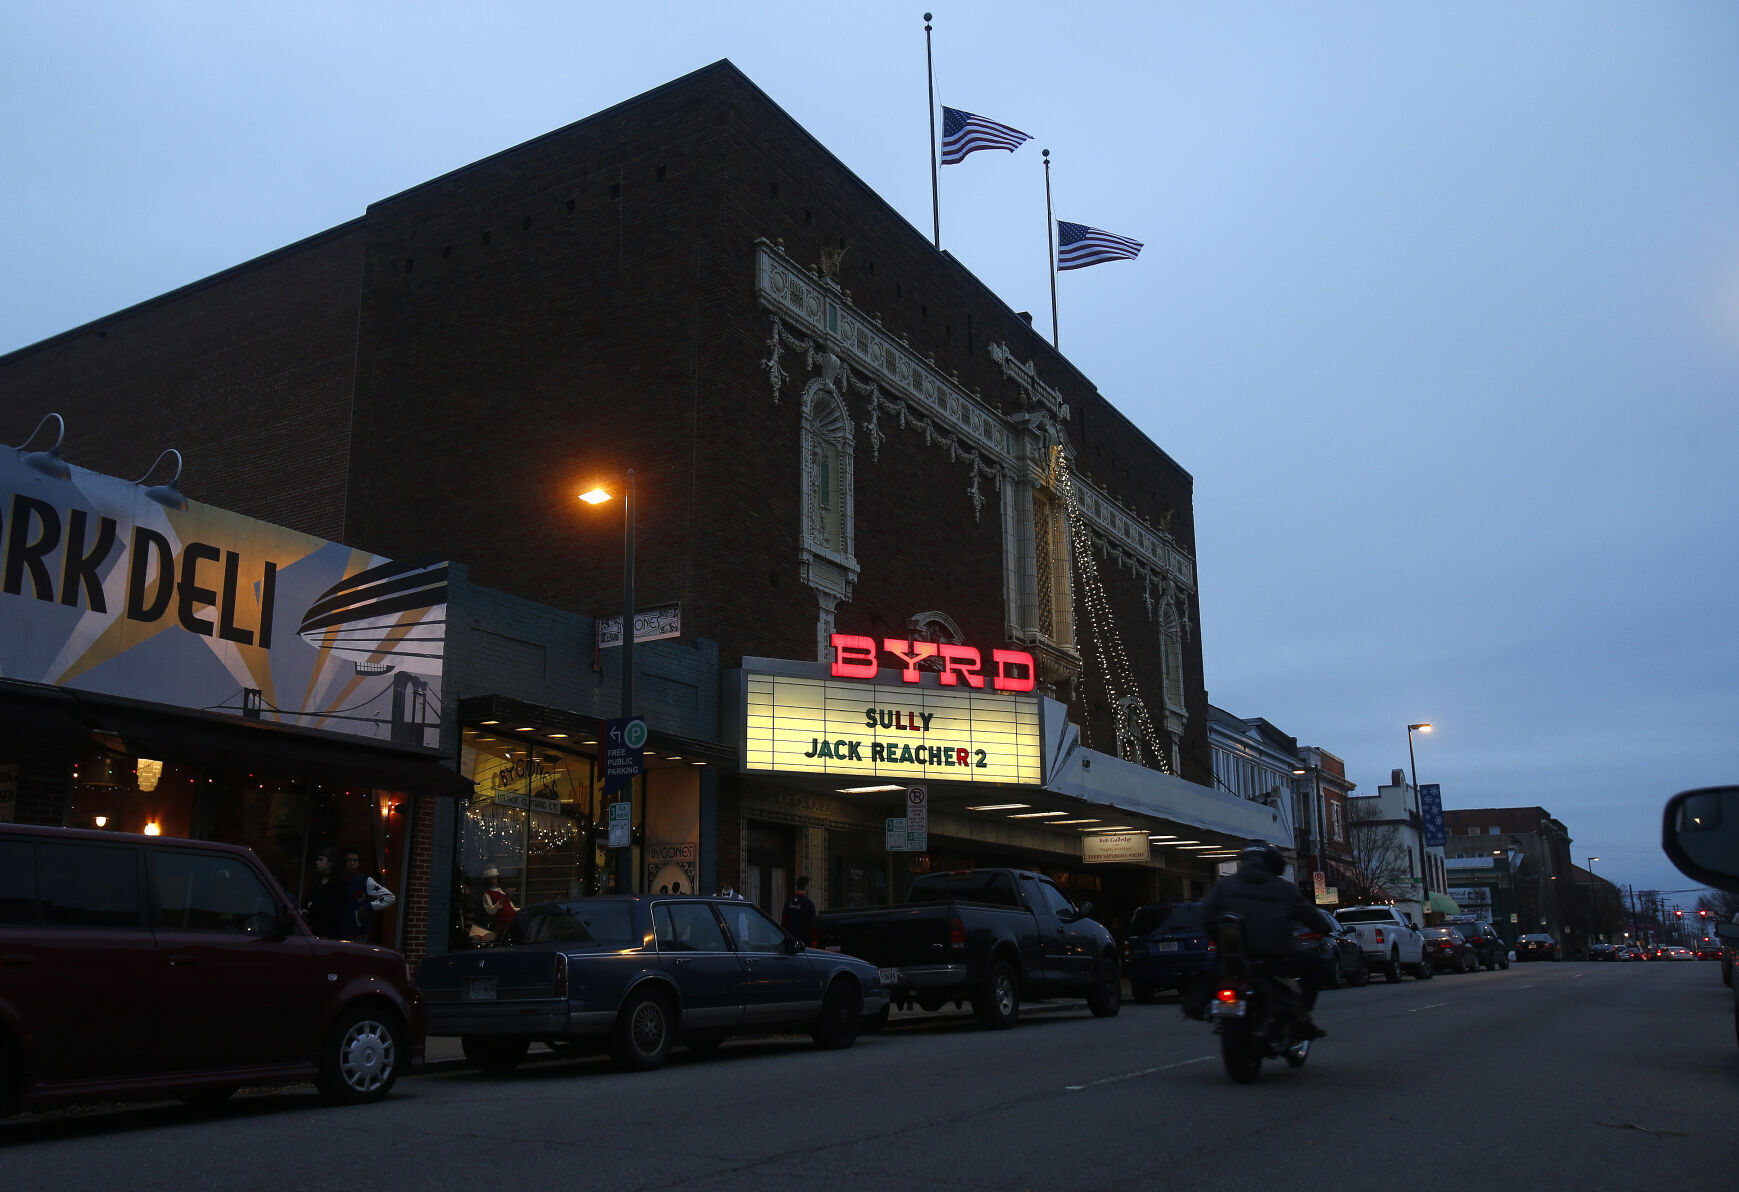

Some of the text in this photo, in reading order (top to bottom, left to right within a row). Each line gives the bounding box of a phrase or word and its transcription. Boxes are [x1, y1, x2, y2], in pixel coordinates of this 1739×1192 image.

[0, 493, 277, 649] RK DELI
[831, 633, 1035, 692] BYRD
[865, 708, 934, 731] SULLY
[608, 749, 626, 757] FREE
[608, 757, 633, 766] PUBLIC
[804, 738, 987, 767] JACK REACHER 2
[608, 766, 639, 776] PARKING
